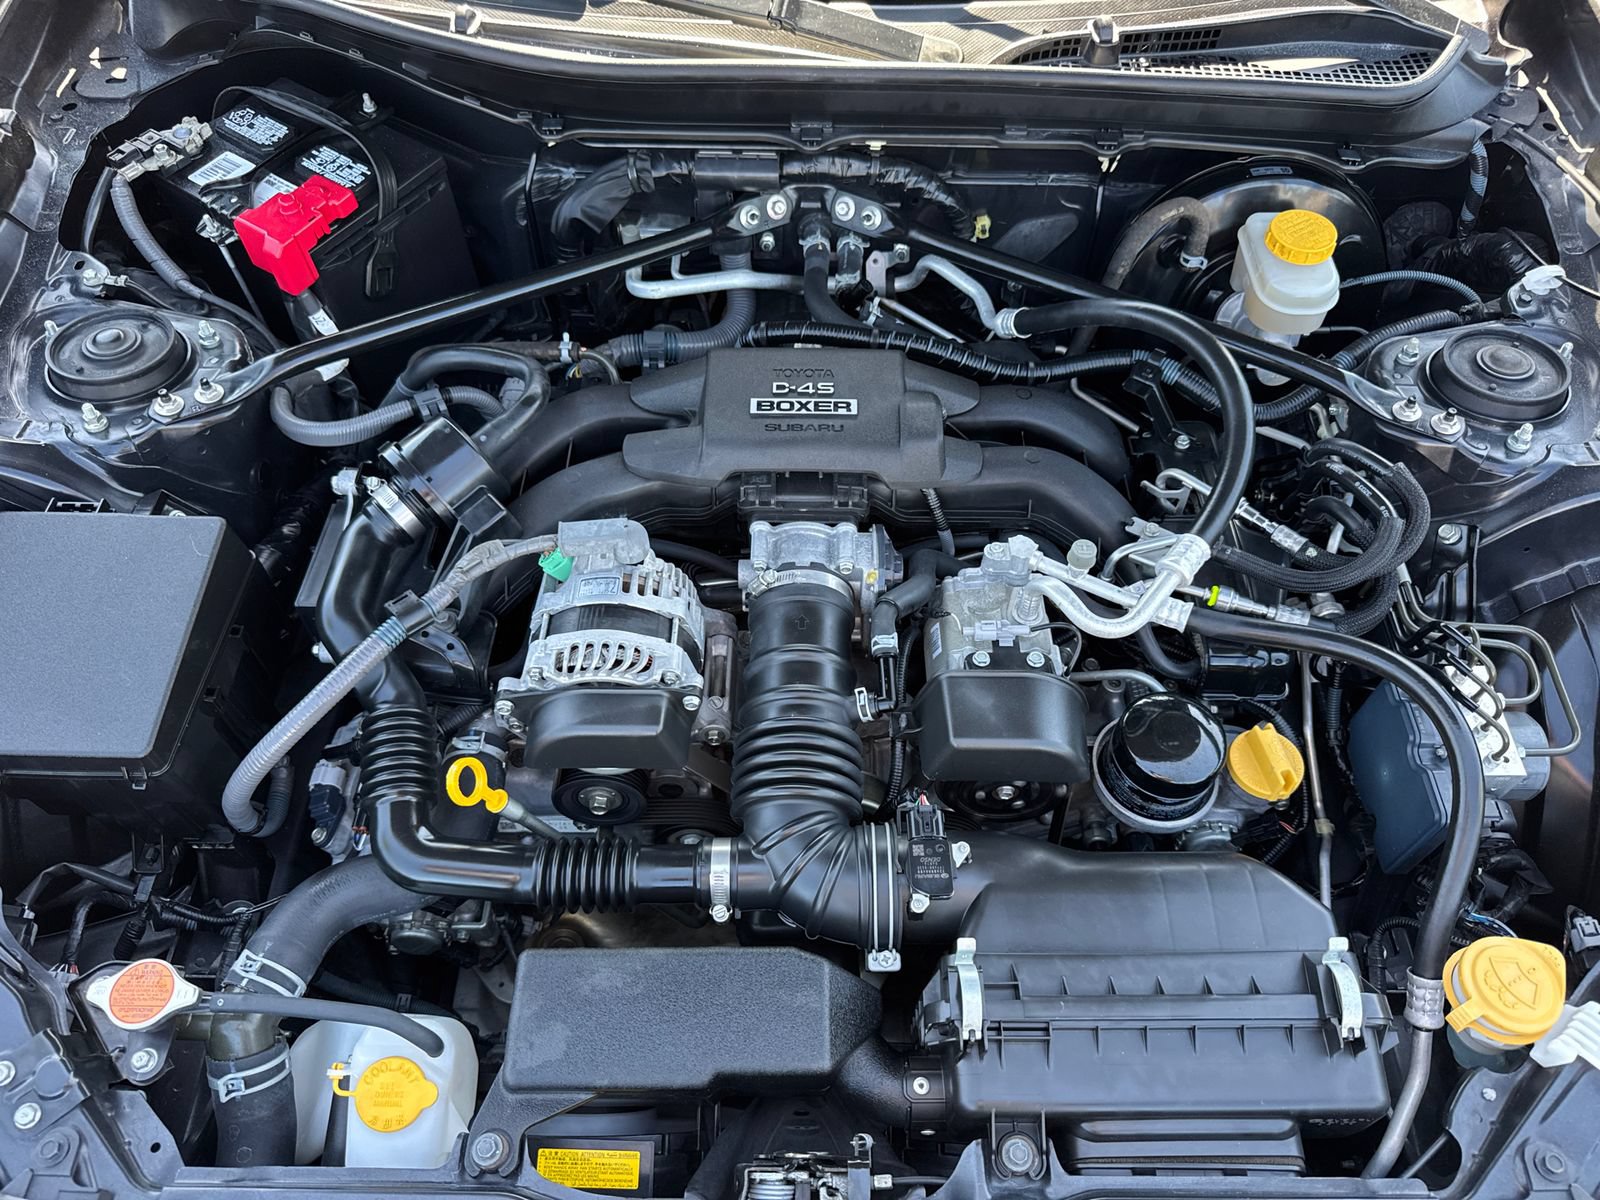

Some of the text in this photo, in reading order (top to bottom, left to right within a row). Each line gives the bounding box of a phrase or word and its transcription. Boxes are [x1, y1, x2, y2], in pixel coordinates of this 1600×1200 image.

[772, 368, 835, 378] TOYOTA
[772, 382, 835, 394] D-4S
[756, 400, 852, 412] BOXER
[764, 423, 845, 433] SUBARU
